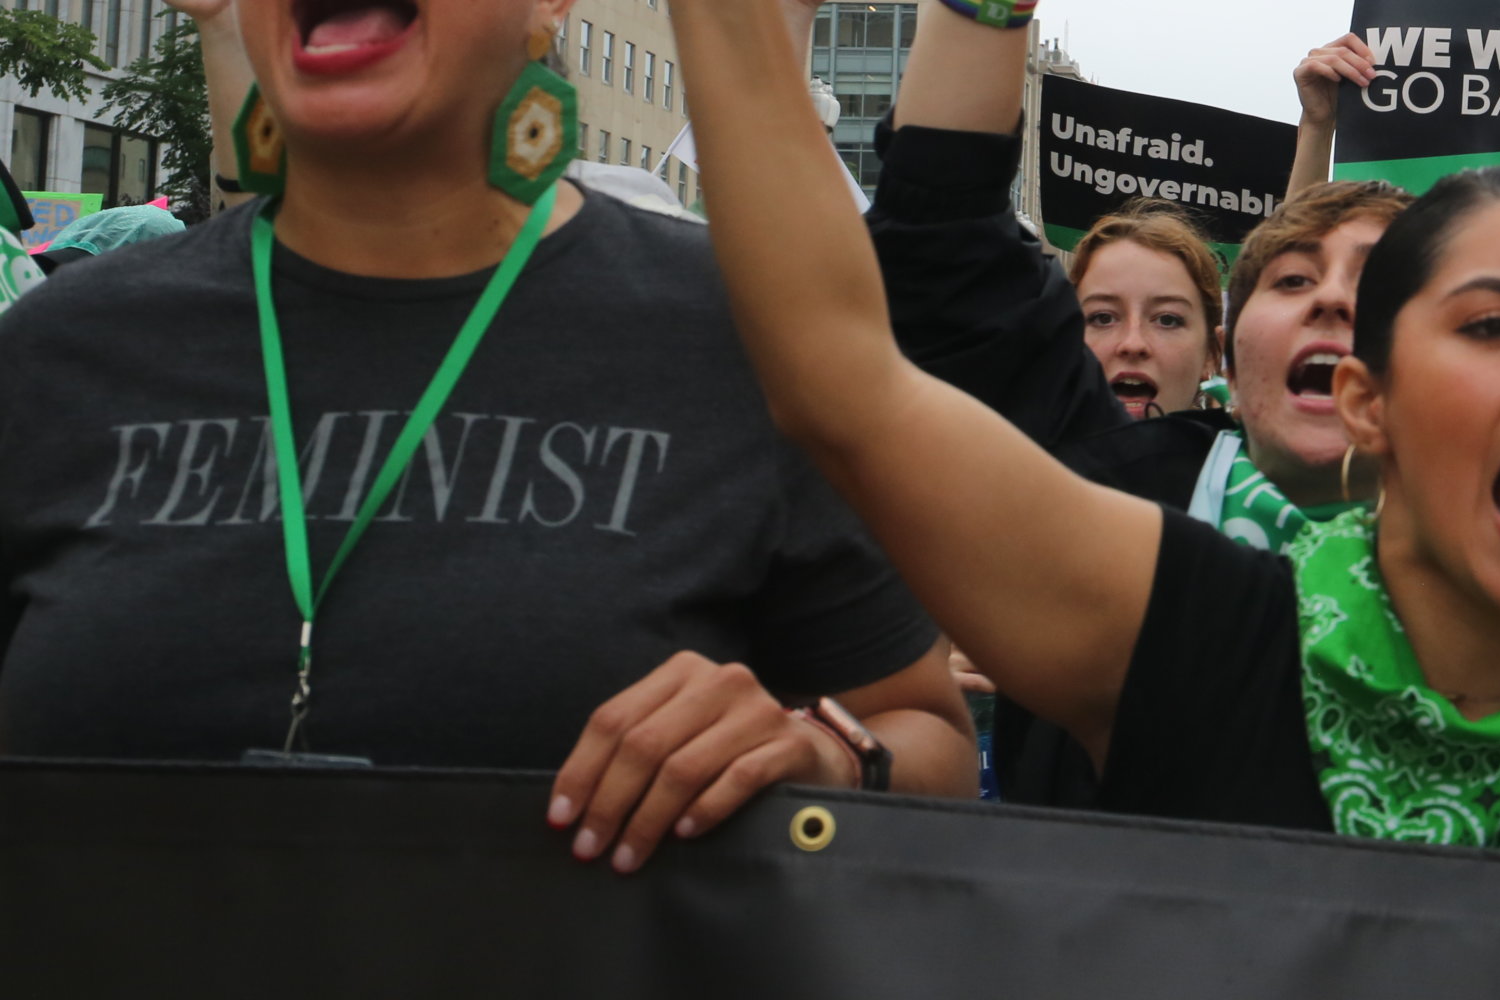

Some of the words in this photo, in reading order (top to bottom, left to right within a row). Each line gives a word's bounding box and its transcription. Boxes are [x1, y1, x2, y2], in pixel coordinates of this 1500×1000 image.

[1365, 26, 1452, 68] WE
[1360, 69, 1445, 114] GO
[1051, 112, 1214, 168] Unafraid.
[1050, 151, 1285, 218] Ungovernabl
[84, 410, 671, 538] FEMINIST
